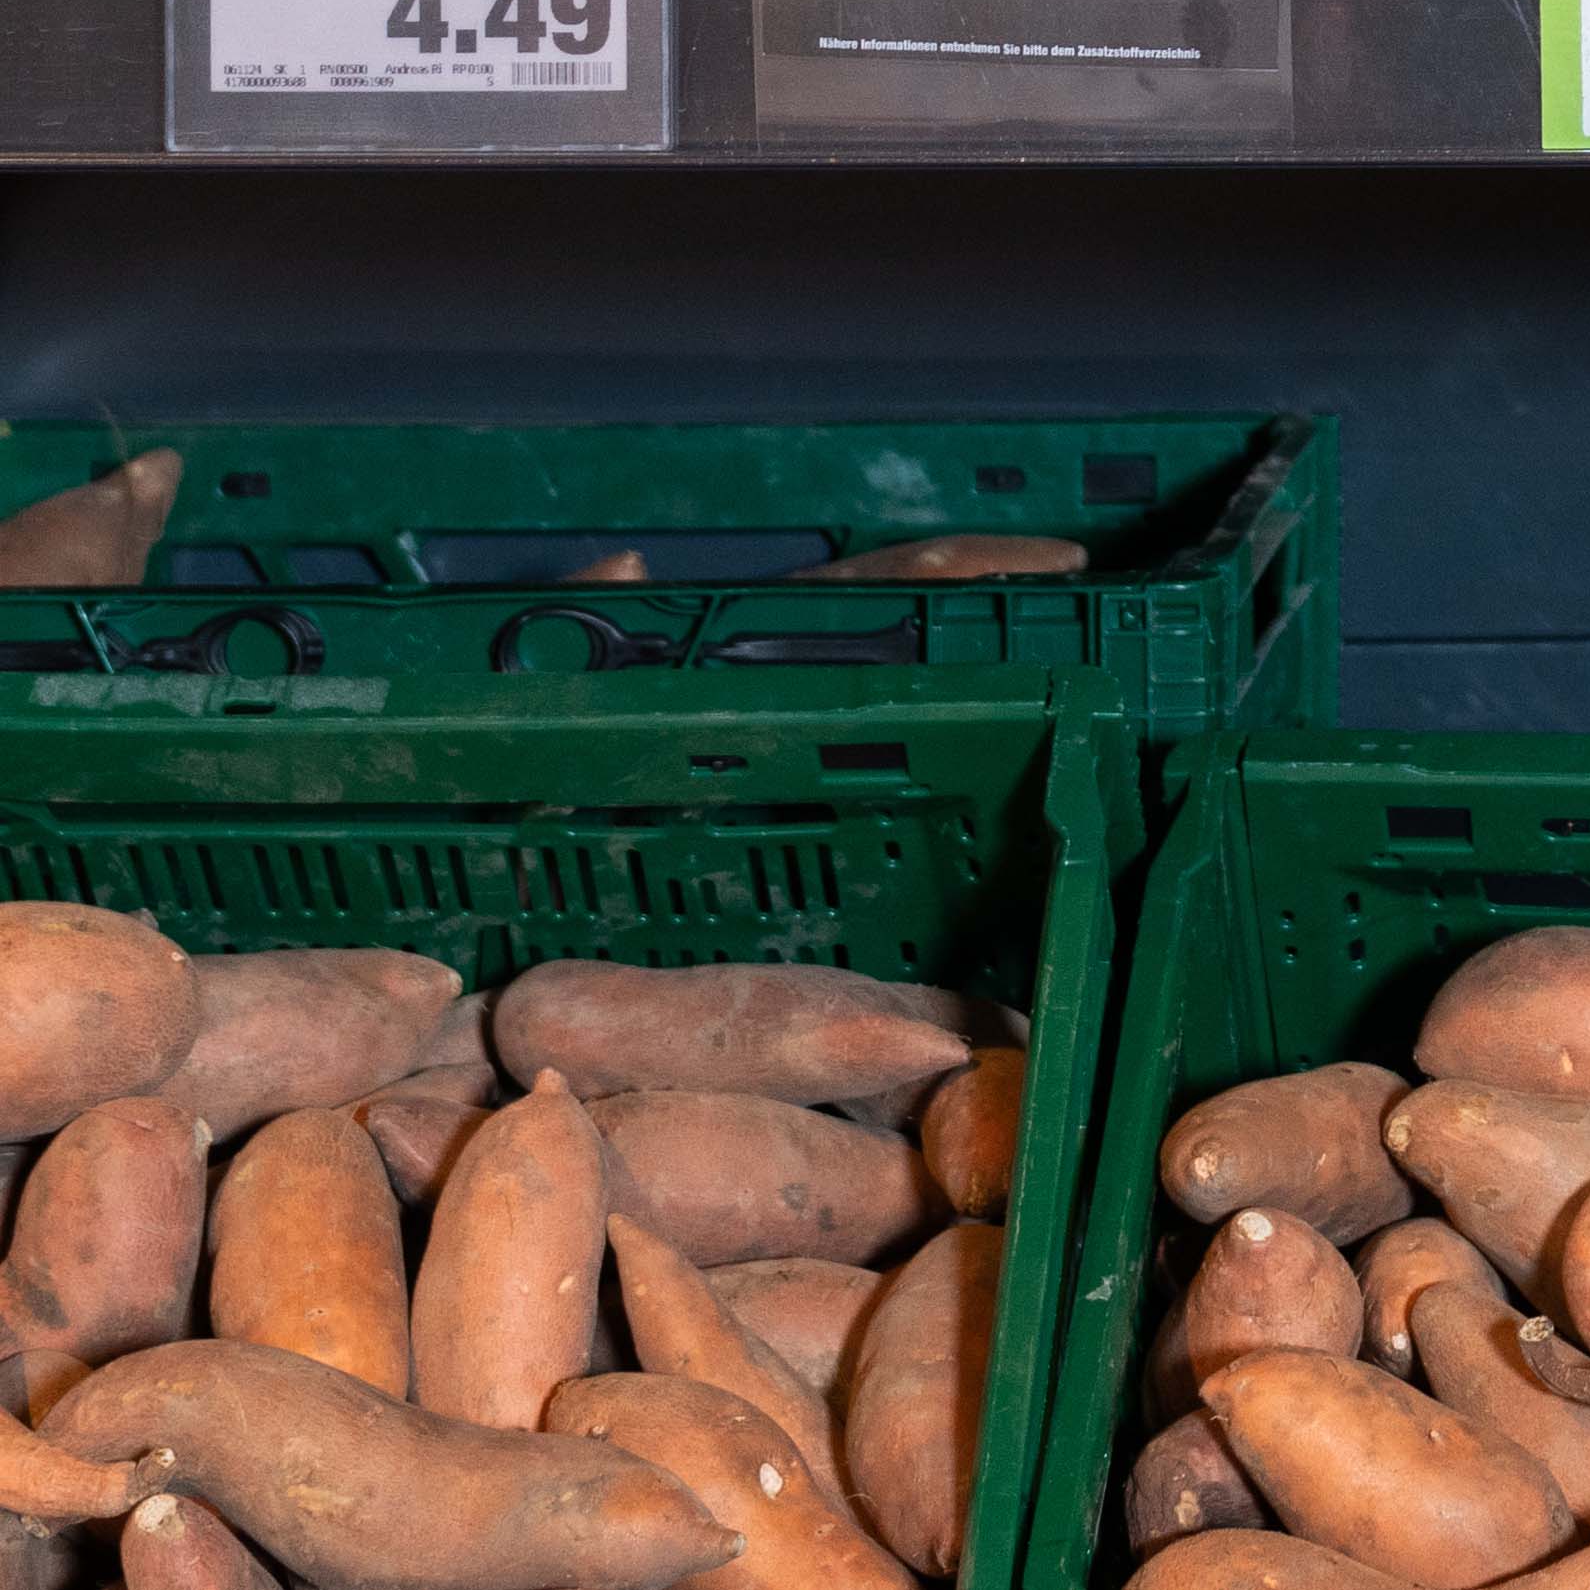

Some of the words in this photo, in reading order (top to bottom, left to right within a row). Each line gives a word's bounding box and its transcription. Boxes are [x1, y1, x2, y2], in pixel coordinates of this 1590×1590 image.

[819, 37, 858, 50] Nähere
[861, 39, 937, 52] Informationen
[940, 42, 1000, 54] entnehmen
[1003, 43, 1020, 55] Sie
[1023, 44, 1048, 56] bitte
[1051, 45, 1075, 56] dem
[1078, 45, 1200, 59] Zusatzstoffverzeichnis
